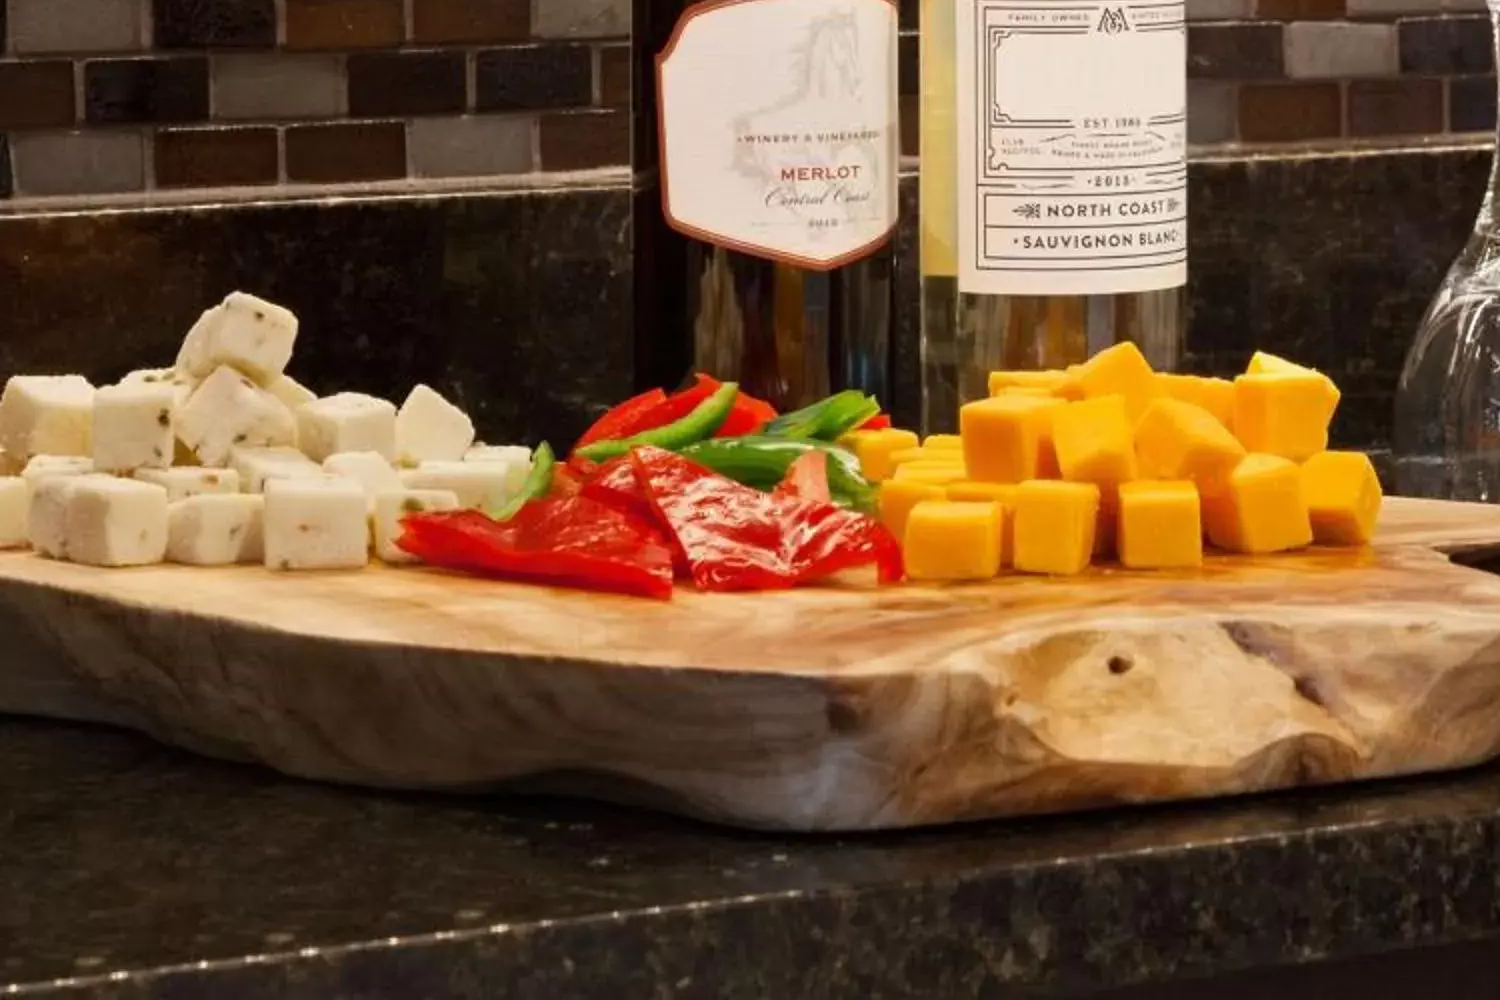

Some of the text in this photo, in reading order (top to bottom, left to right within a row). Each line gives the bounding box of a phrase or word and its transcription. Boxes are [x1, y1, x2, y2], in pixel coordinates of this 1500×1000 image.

[1083, 117, 1107, 128] EST
[743, 134, 798, 144] WINERY
[781, 165, 861, 182] MERLOT
[1046, 200, 1164, 218] NORTH COAST
[1023, 233, 1133, 249] SAUVIGNON
